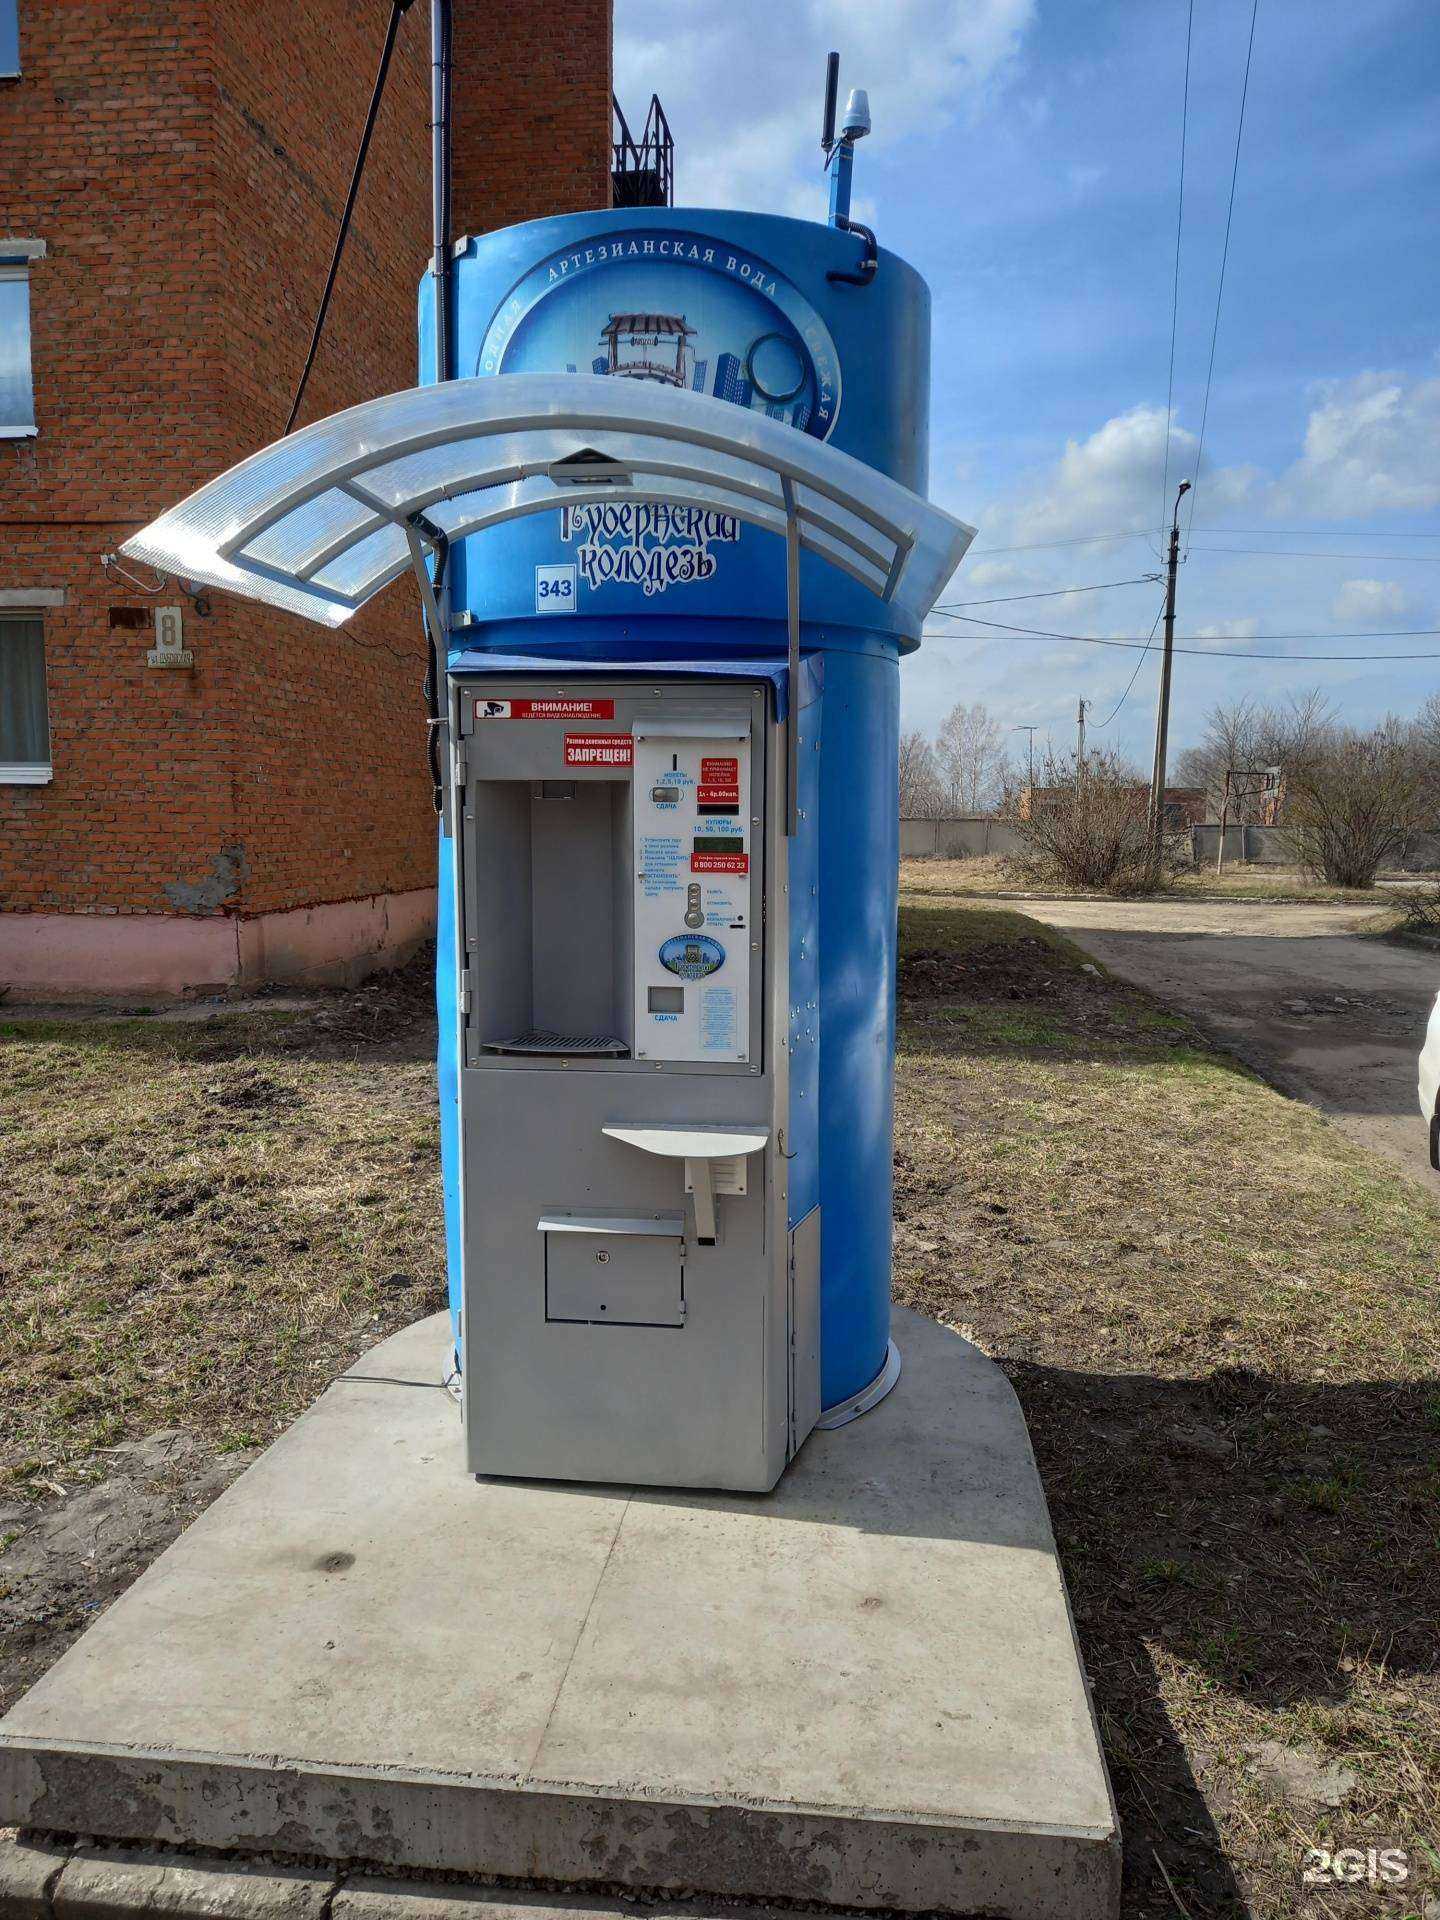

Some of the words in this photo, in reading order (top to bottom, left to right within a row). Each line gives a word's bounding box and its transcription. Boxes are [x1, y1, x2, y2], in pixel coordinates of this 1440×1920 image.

[546, 238, 716, 283] АРТЕЗИАНСКАЯ
[726, 256, 778, 297] ВОДА
[539, 579, 572, 598] 343
[531, 702, 593, 712] ВНИМАНИЕ!
[567, 748, 631, 763] ЗАПРЕЩЕН!
